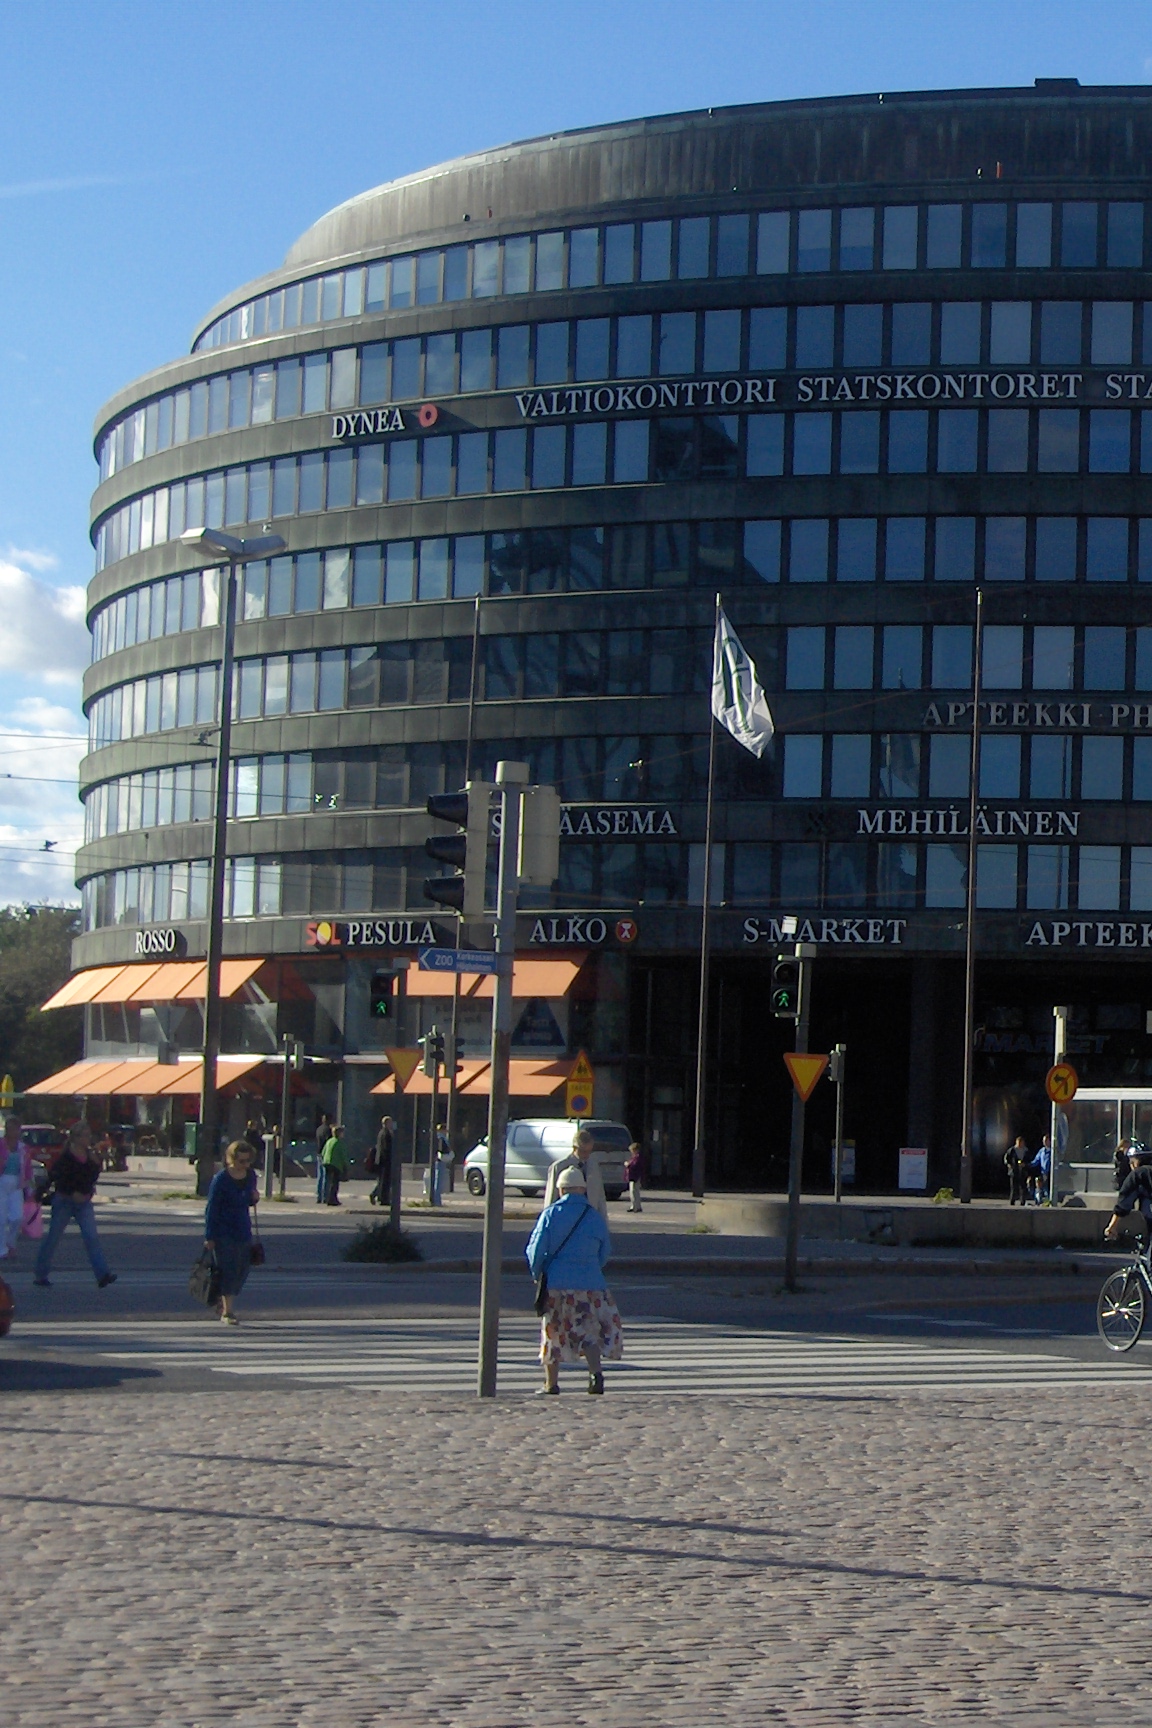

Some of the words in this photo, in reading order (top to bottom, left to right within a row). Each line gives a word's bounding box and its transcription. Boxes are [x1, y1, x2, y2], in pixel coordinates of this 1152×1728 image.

[515, 378, 776, 418] VALTIOKONTTORI
[797, 373, 1083, 402] STATSKONTORET
[331, 407, 405, 439] DYNEA
[921, 701, 1092, 728] APTEEKKI
[490, 805, 678, 838] SÄASEMA
[856, 804, 1081, 837] MEHILÄINEN
[135, 928, 176, 954] ROSSO
[305, 921, 342, 946] SOL
[347, 920, 437, 946] PESULA
[529, 916, 608, 943] ALKO
[743, 917, 907, 944] S-MARKET
[434, 954, 454, 966] ZOO
[984, 1033, 1111, 1053] MARET
